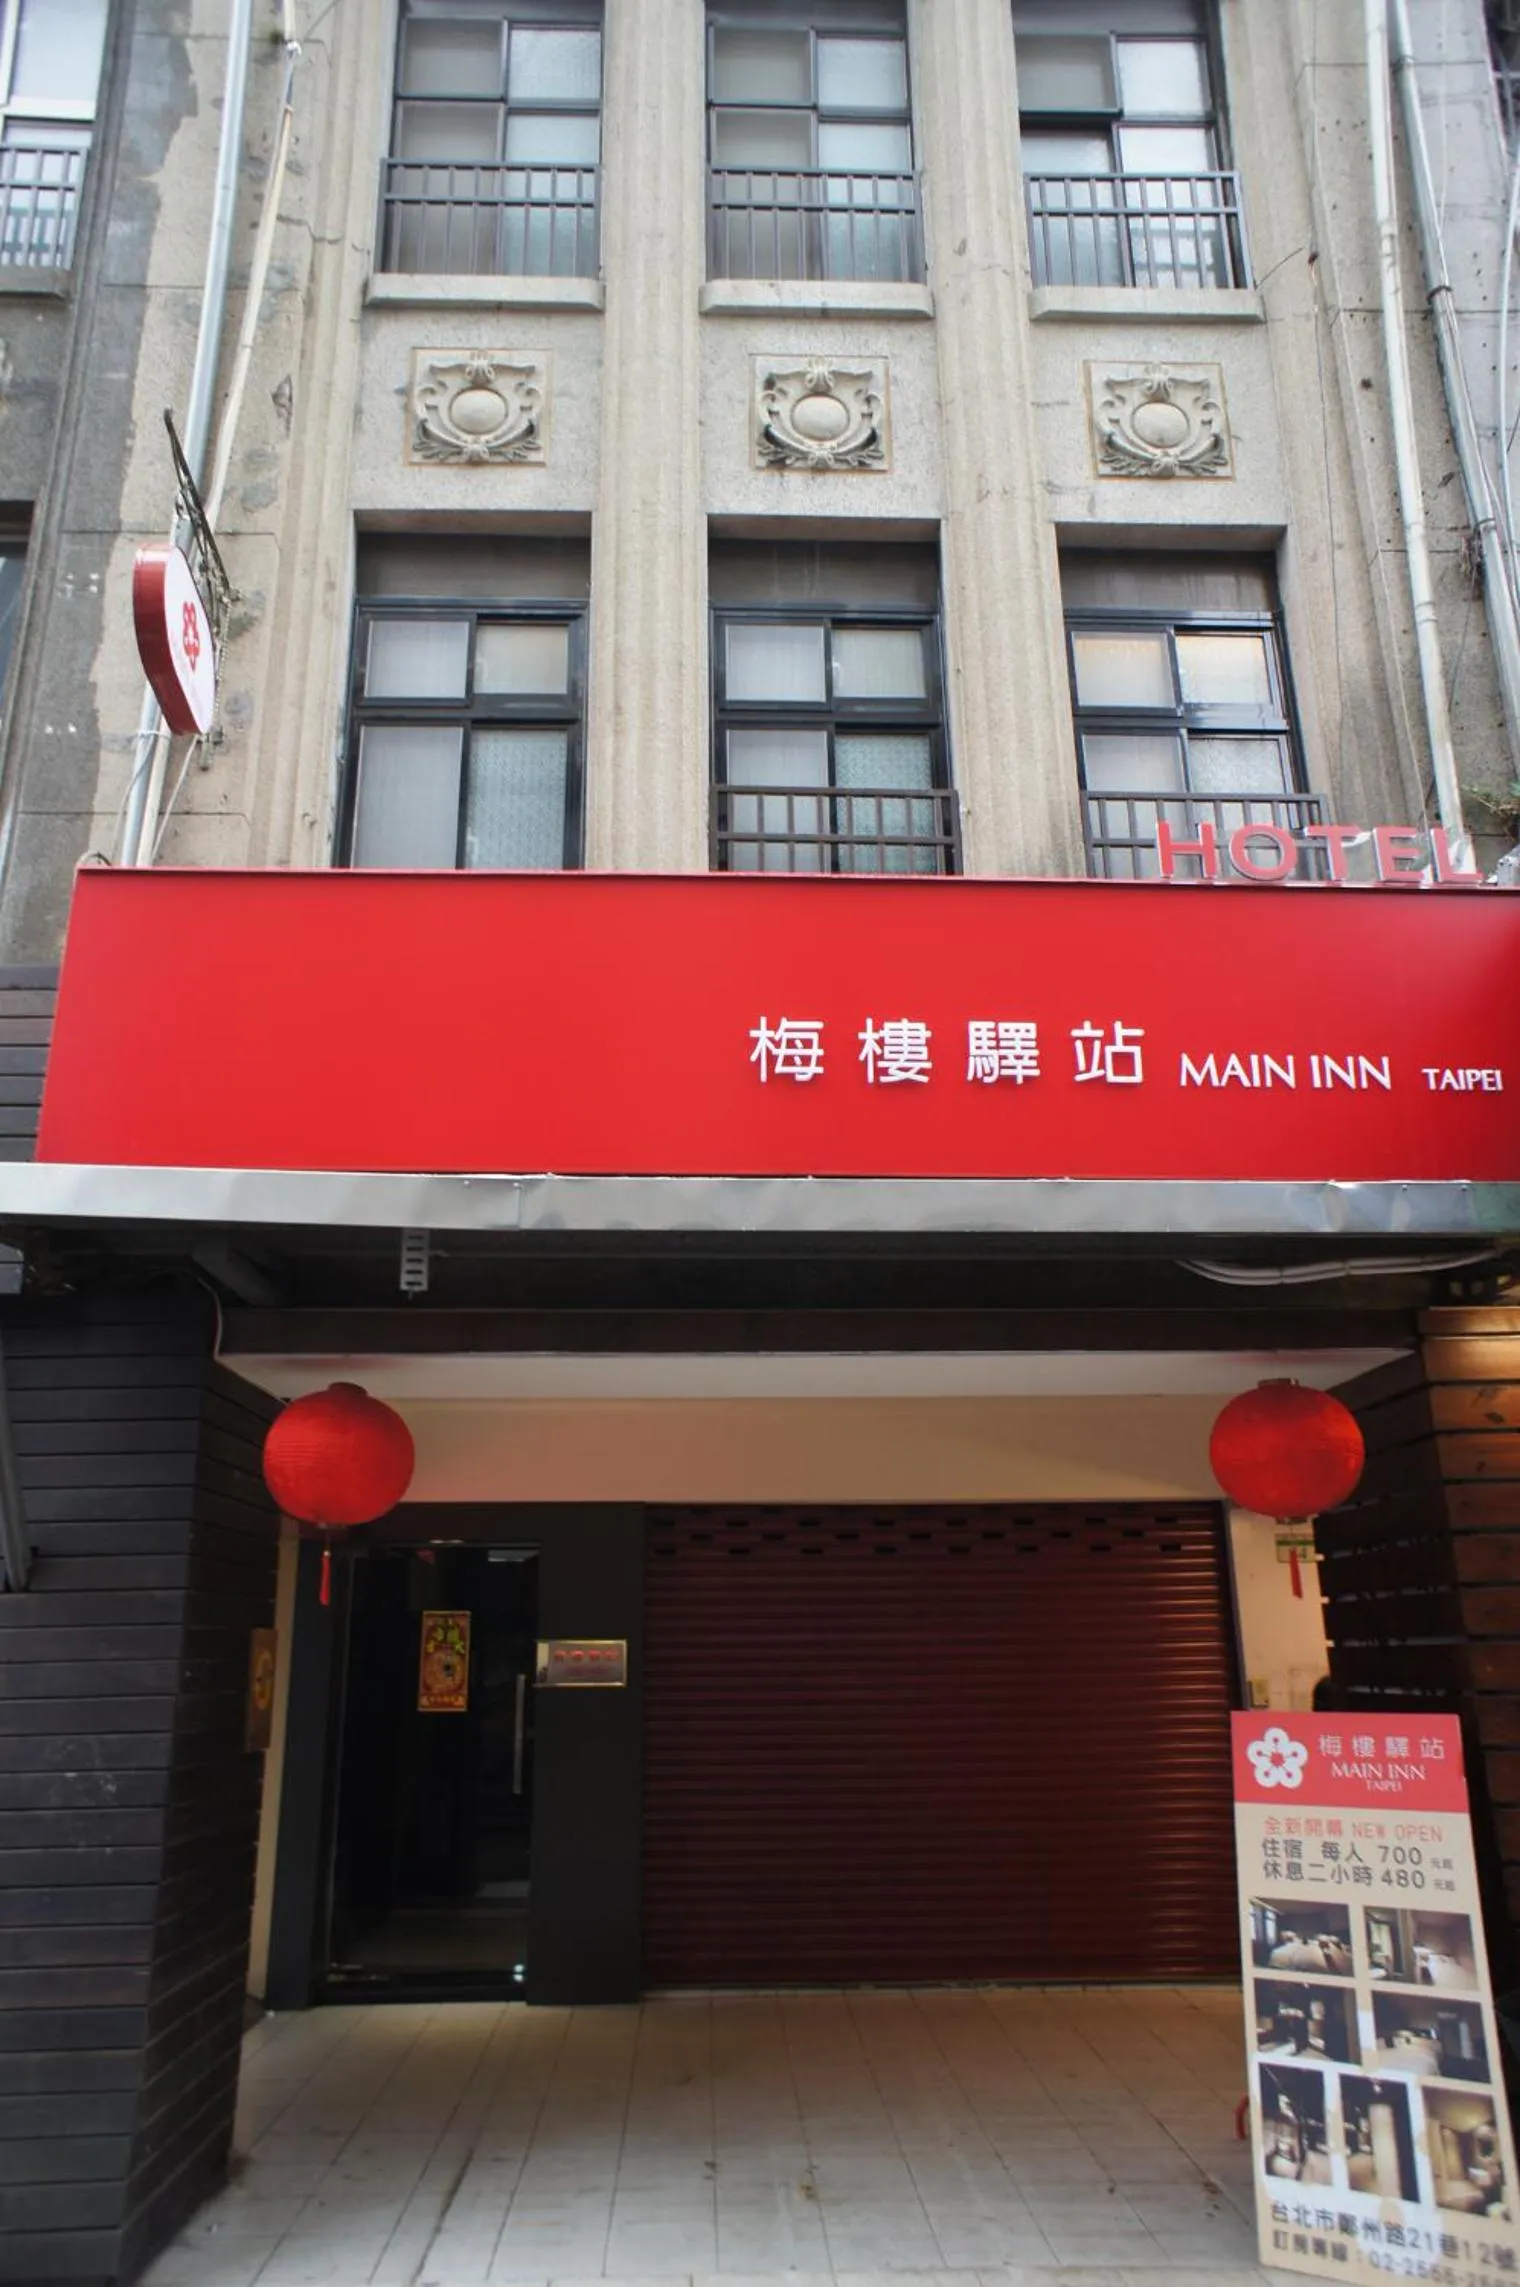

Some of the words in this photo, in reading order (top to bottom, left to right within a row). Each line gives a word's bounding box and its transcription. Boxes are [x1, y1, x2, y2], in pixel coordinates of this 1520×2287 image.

[1156, 822, 1483, 884] HOTEL
[749, 1016, 1145, 1086] 梅樓驛站
[1180, 1053, 1296, 1090] MAIN
[1311, 1055, 1392, 1091] INN
[1421, 1068, 1504, 1092] TAIPEI
[1331, 1761, 1383, 1780] MAIN
[1388, 1763, 1427, 1781] INN
[1366, 1779, 1403, 1793] TAIPEI
[1352, 1822, 1387, 1840] NEW
[1394, 1824, 1444, 1843] OPEN
[1377, 1844, 1423, 1866] 700
[1380, 1868, 1426, 1890] 480
